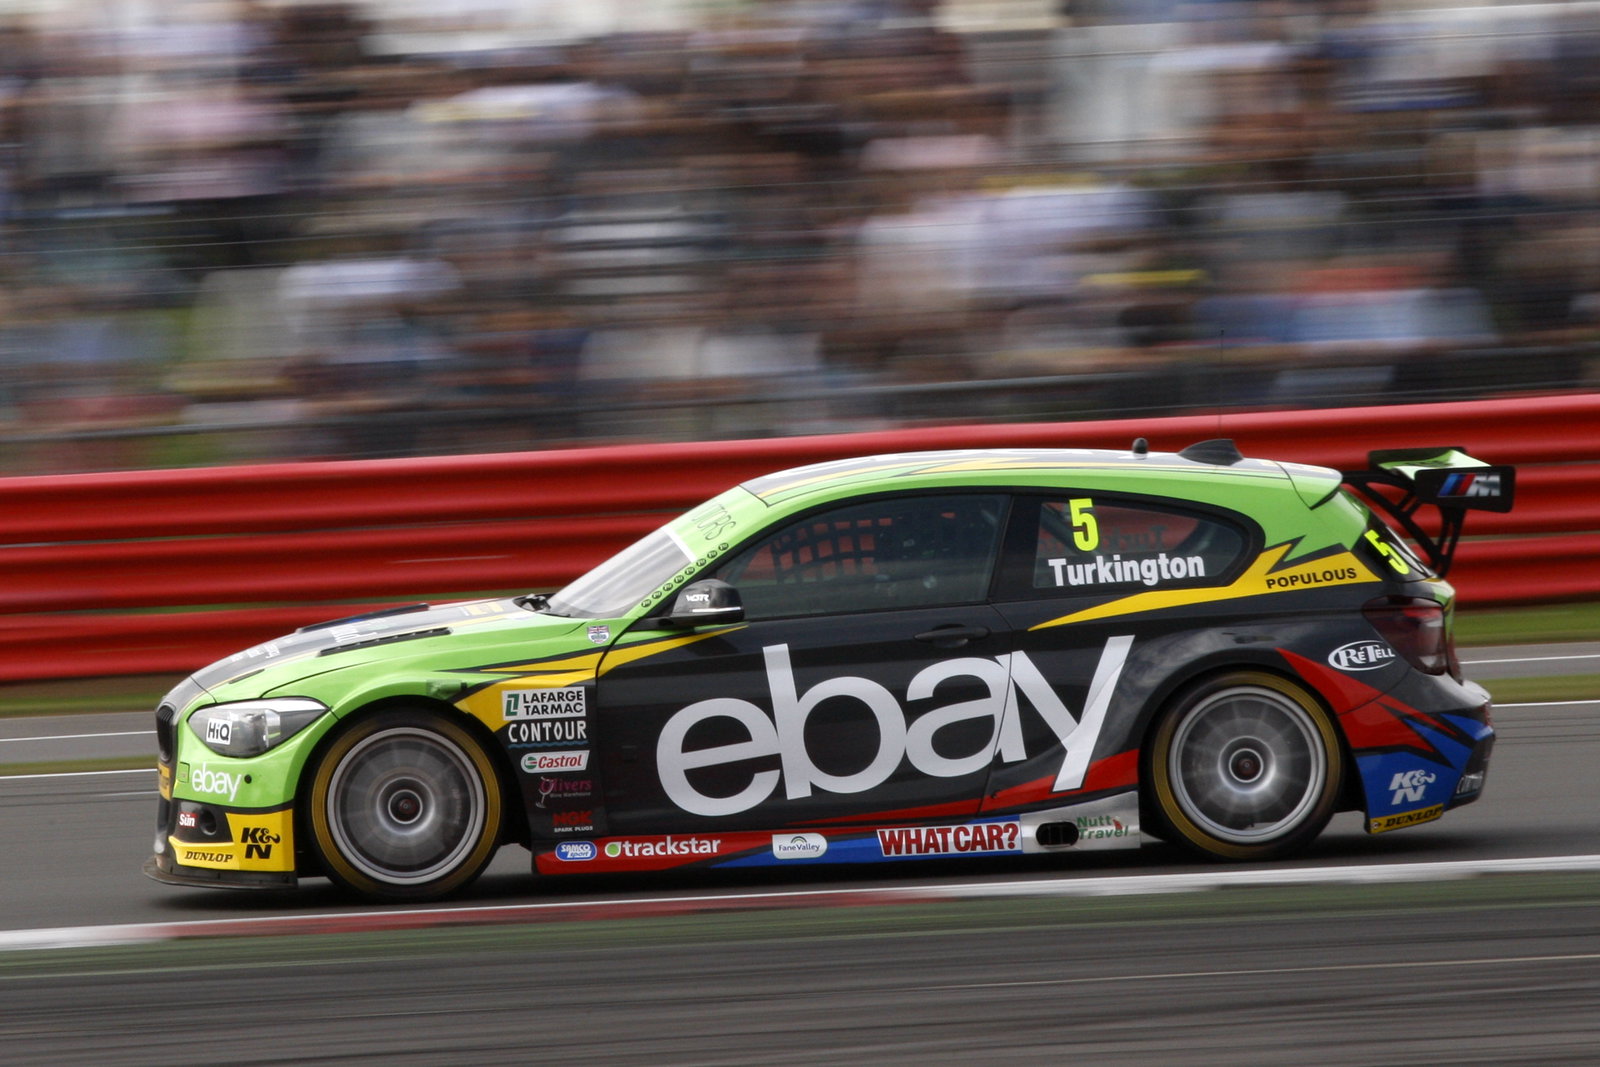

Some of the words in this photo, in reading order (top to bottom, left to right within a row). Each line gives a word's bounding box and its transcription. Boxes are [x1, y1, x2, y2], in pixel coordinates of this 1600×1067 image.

[1069, 498, 1099, 551] 5
[1364, 529, 1410, 575] 5
[1048, 553, 1204, 586] Turkington
[1265, 567, 1357, 590] POPULOUS
[523, 690, 583, 704] LAFARGE
[524, 702, 583, 716] TARMAC
[208, 720, 230, 742] HiQ
[508, 720, 587, 743] CONTOUR
[656, 635, 1136, 818] ebay
[538, 754, 582, 770] Castrol
[192, 763, 243, 802] ebay
[552, 810, 593, 826] NGK
[1077, 815, 1113, 828] Nutt
[1384, 803, 1443, 828] DUNLOP
[1079, 825, 1129, 840] Travel
[184, 850, 234, 863] DUNLOP
[622, 836, 721, 857] trackstar
